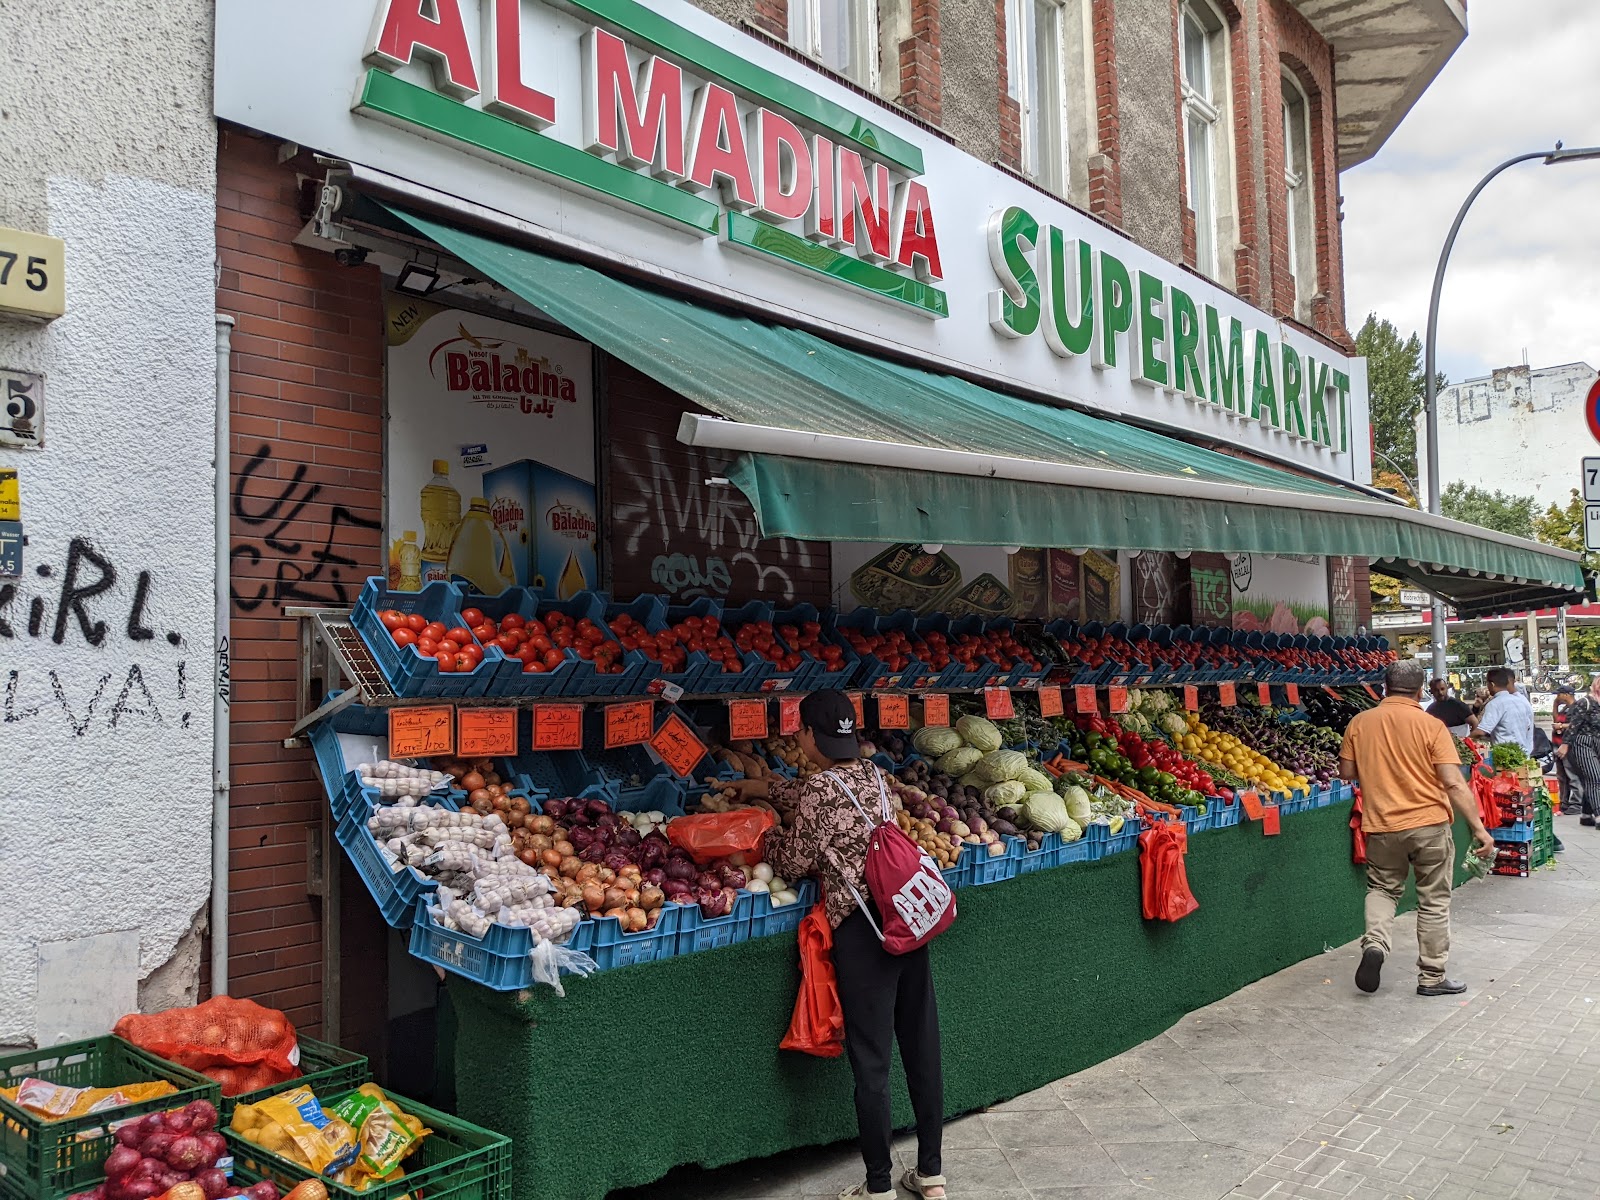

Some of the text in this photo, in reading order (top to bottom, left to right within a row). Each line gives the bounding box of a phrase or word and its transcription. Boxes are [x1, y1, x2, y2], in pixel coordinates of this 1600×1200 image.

[374, 0, 944, 282] AL MADINA
[0, 251, 48, 292] 75
[391, 303, 418, 332] NEW
[992, 205, 1350, 455] SUPERMARKT
[445, 350, 577, 403] Baladna
[0, 378, 36, 420] 5
[552, 511, 597, 533] Baladna
[1591, 511, 1600, 521] Li
[891, 551, 909, 572] HALVA
